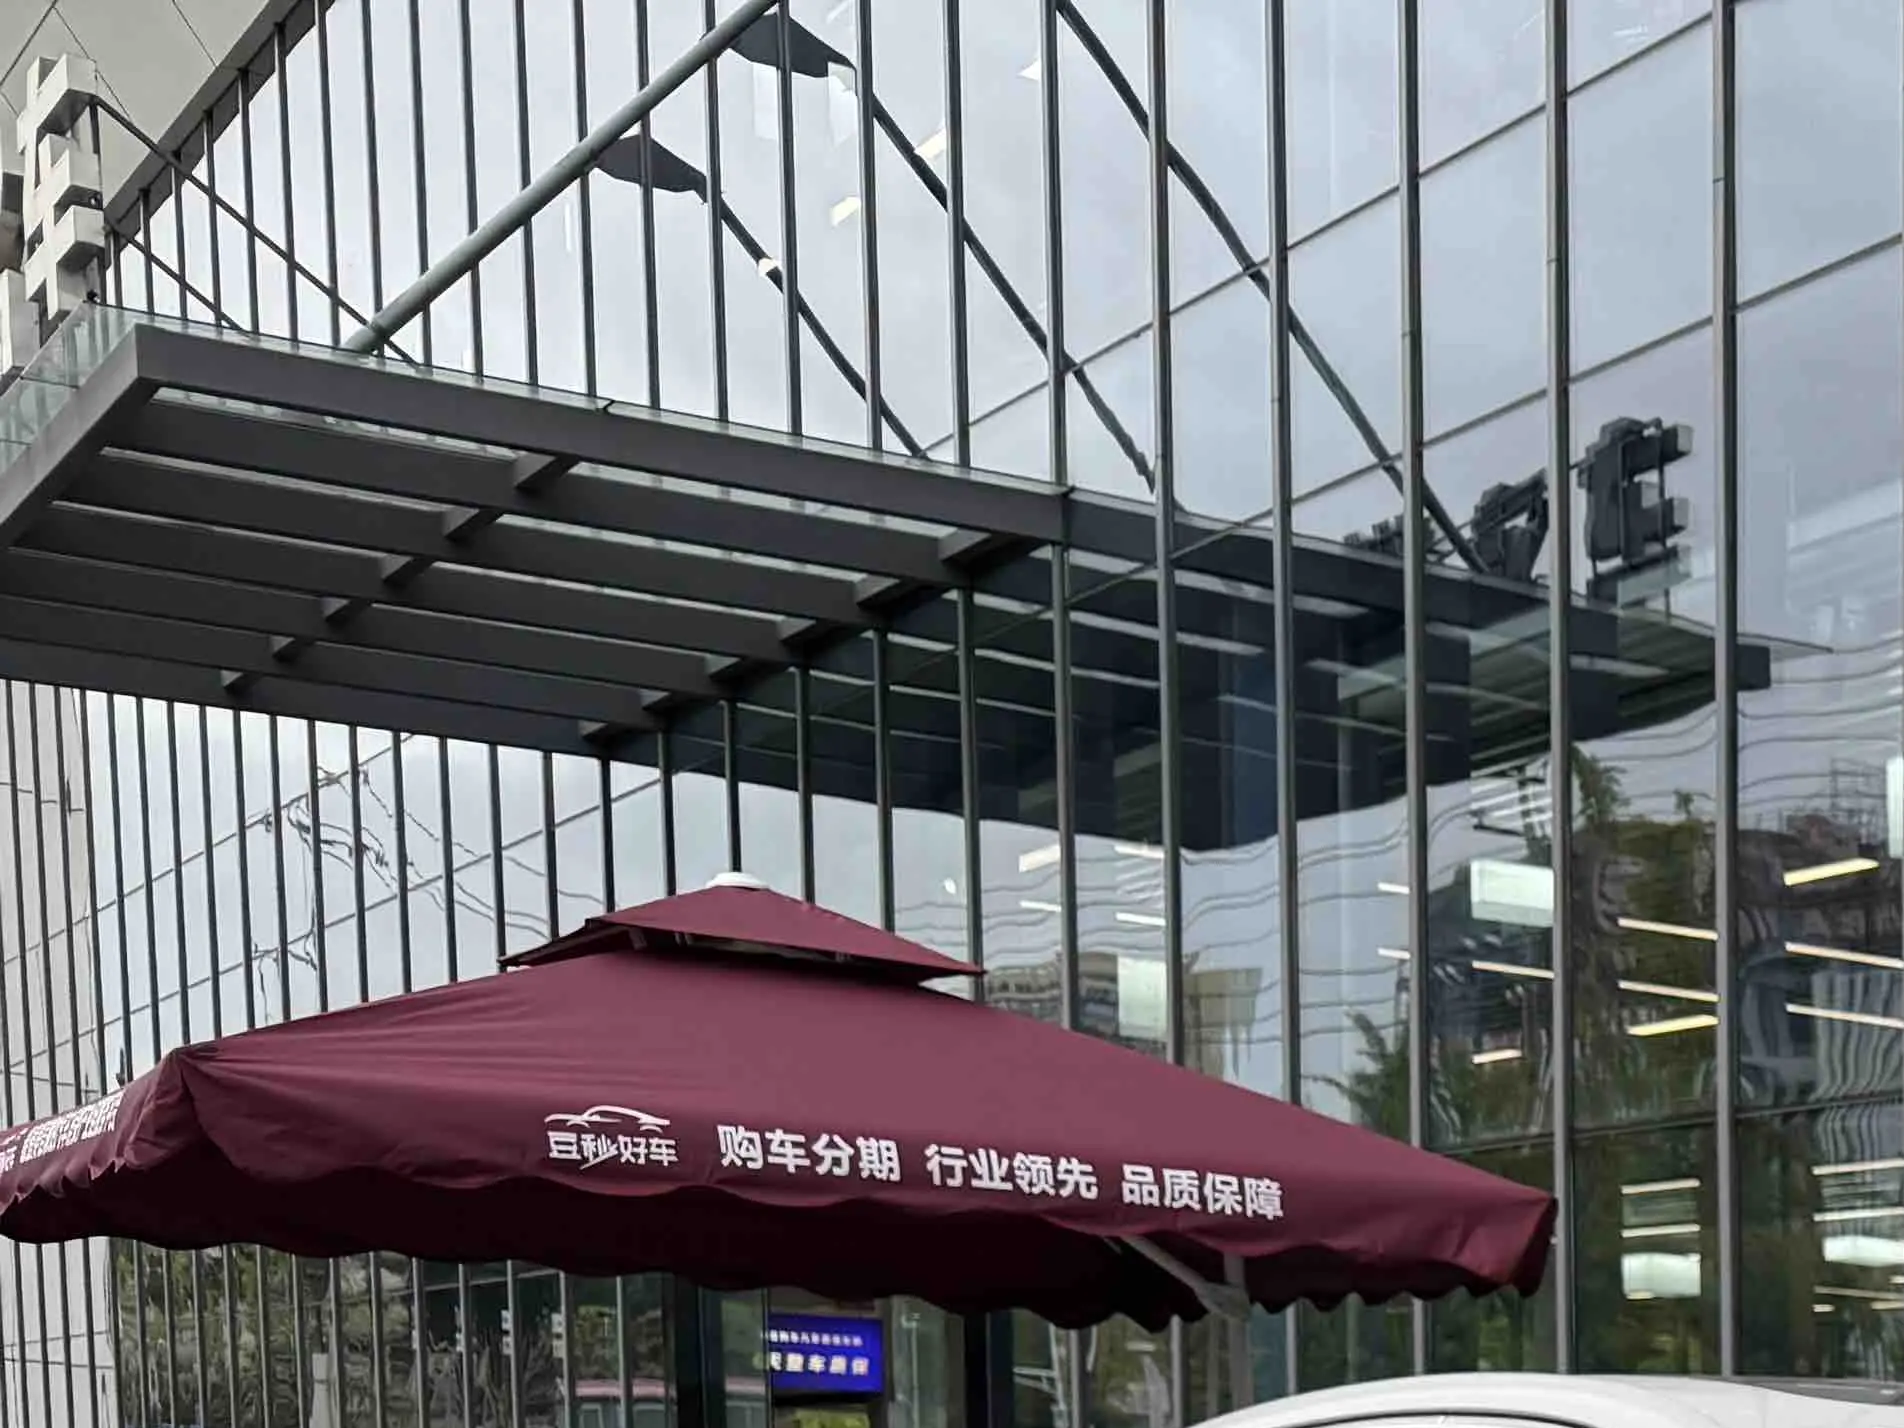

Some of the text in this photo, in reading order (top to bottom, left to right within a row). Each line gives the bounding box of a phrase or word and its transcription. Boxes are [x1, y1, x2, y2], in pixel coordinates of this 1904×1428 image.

[717, 1125, 1284, 1220] 购车分期 行业领先 品质保障
